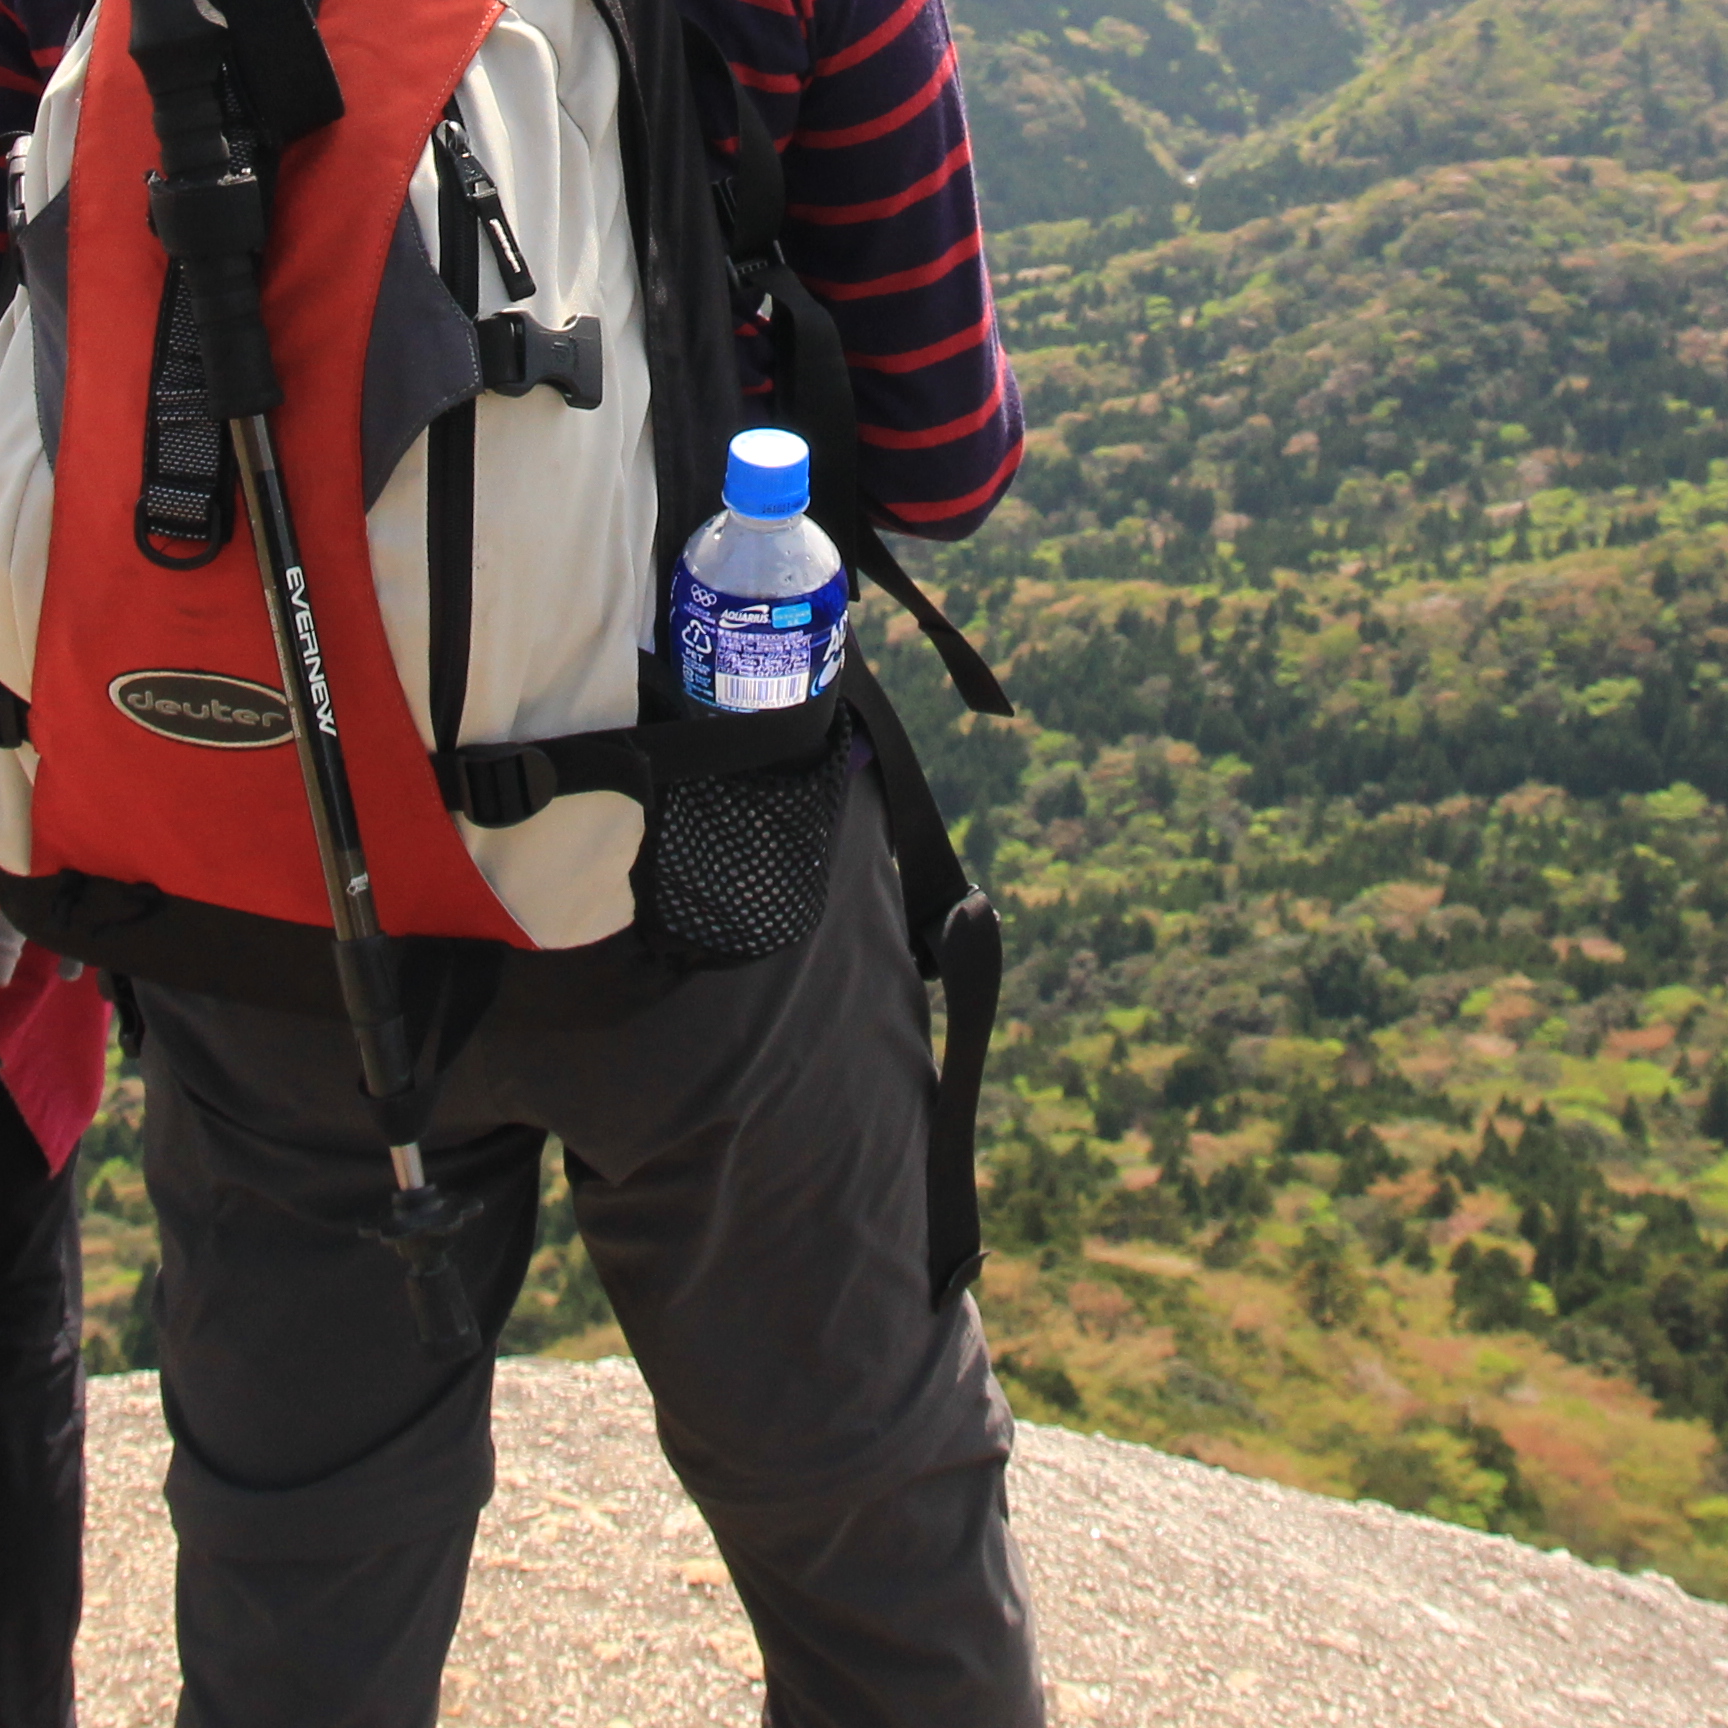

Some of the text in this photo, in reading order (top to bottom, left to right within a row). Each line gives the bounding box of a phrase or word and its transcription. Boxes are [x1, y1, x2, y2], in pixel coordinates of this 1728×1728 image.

[720, 608, 770, 624] AQUARIUS
[285, 565, 337, 737] EVERNEW
[685, 647, 704, 662] PET
[127, 690, 285, 727] deuter
